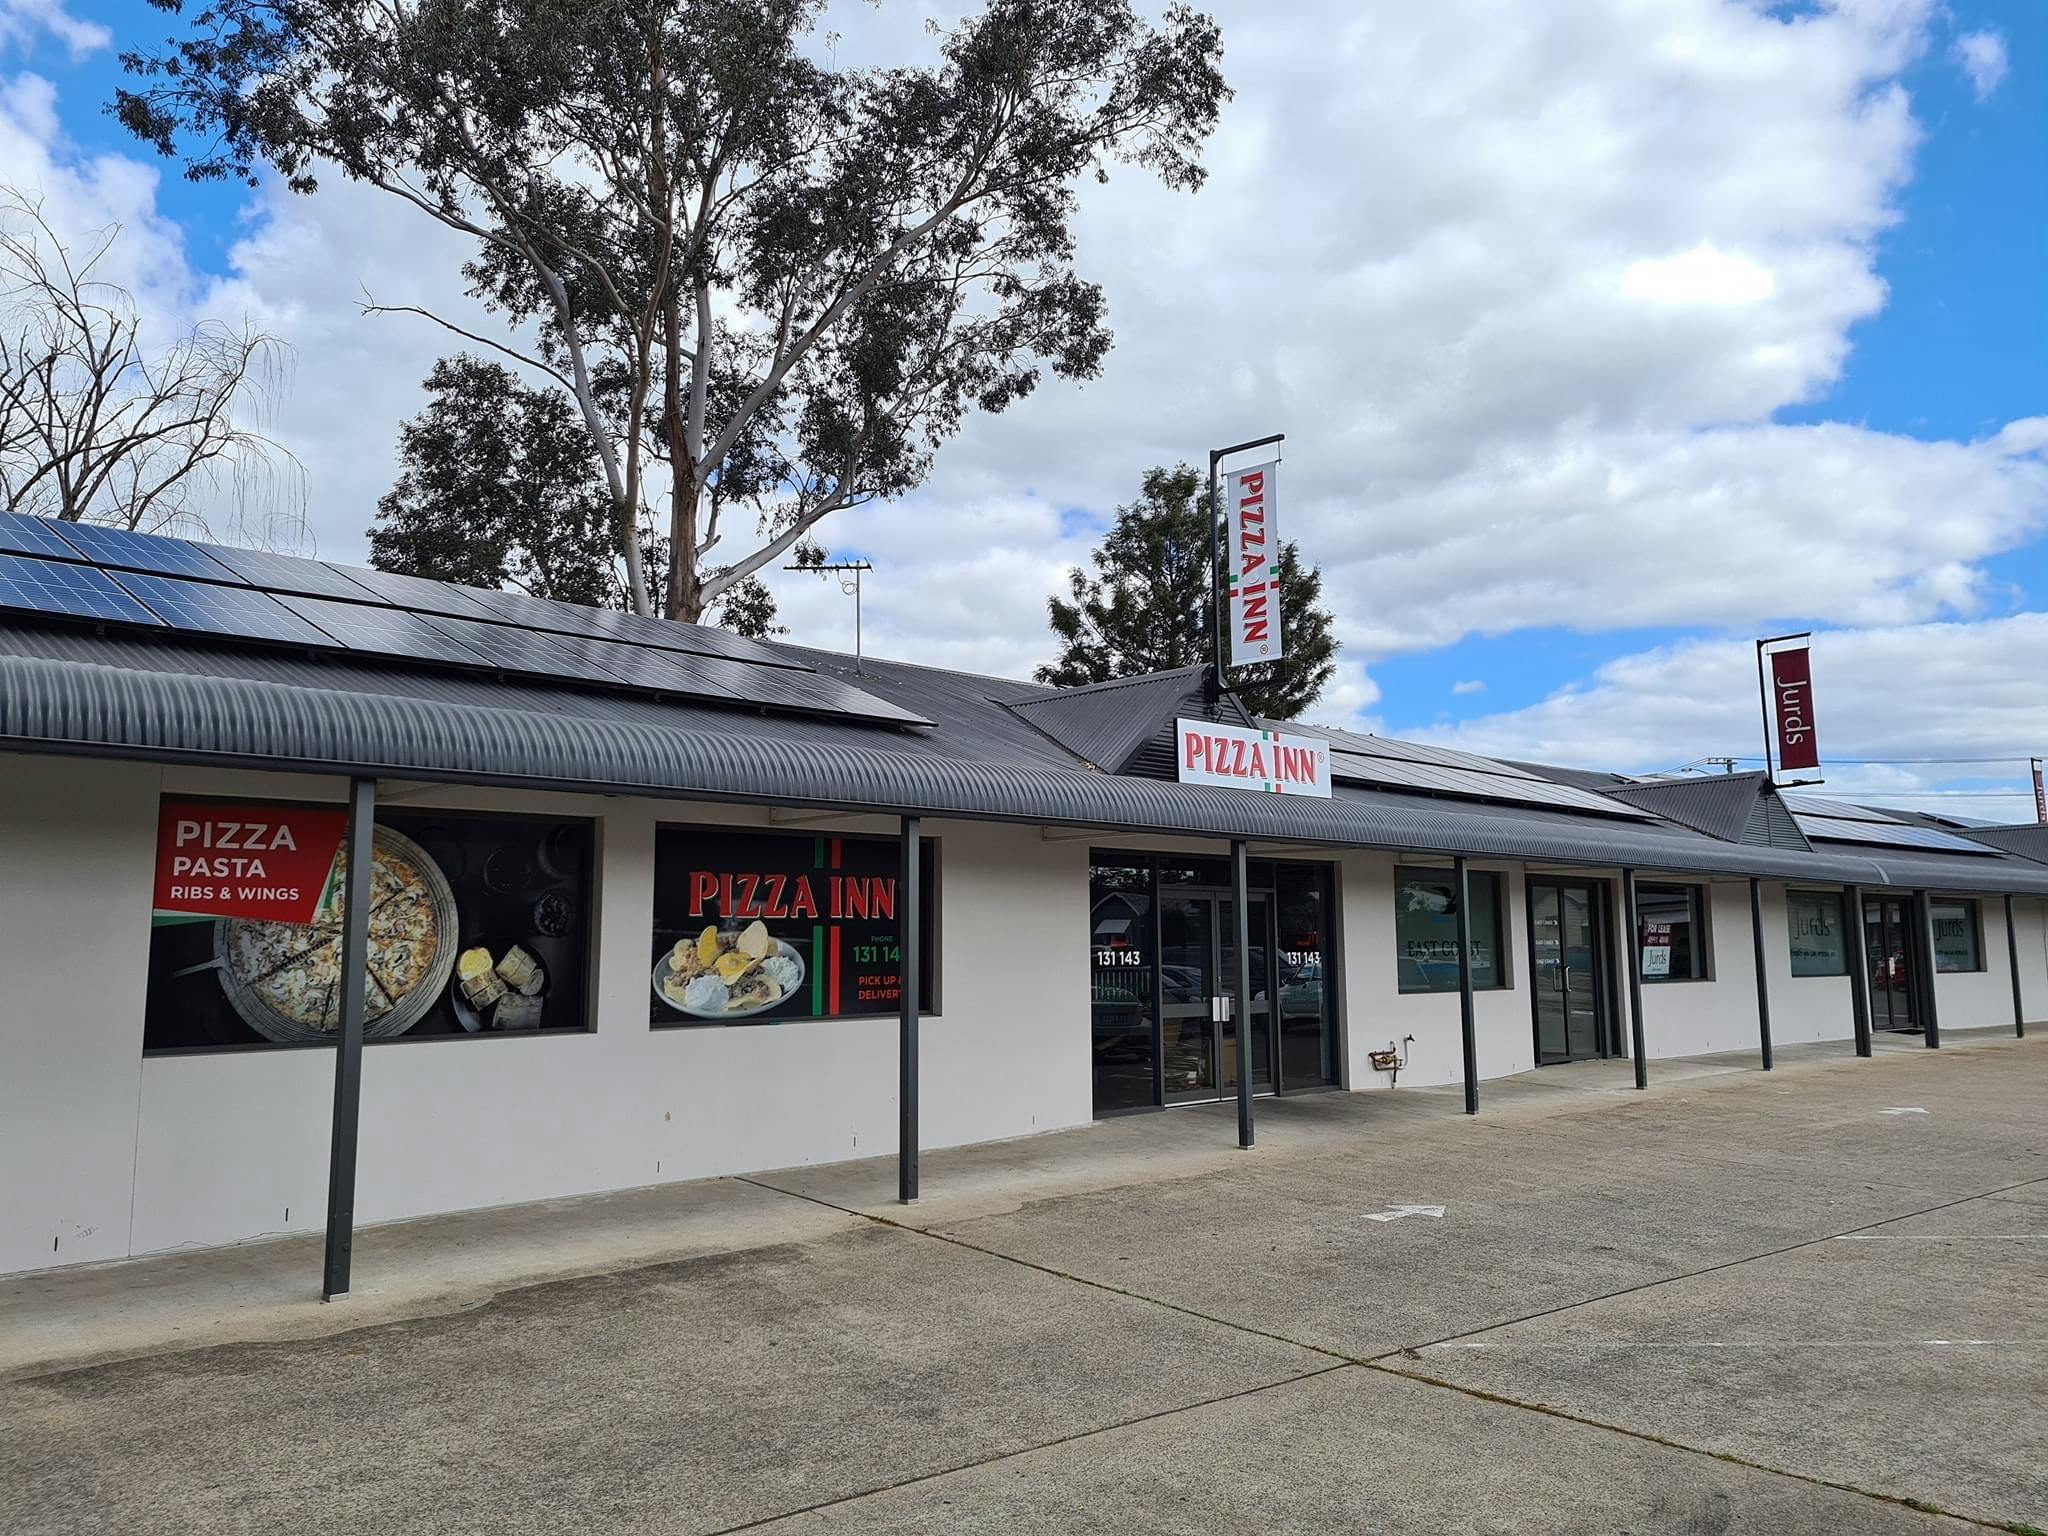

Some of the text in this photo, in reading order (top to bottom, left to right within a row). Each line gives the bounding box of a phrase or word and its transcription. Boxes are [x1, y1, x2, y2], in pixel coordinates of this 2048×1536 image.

[1240, 470, 1268, 644] PIZZA INN
[1776, 676, 1811, 745] Jurds
[1184, 731, 1316, 786] PIZZA INN
[176, 820, 297, 851] PIZZA
[173, 856, 267, 878] PASTA
[170, 886, 300, 901] RIBS & WINGS
[688, 871, 896, 920] PIZZA INN
[1647, 923, 1671, 934] FOR LEASE
[871, 935, 894, 943] PHONE
[853, 945, 901, 963] 131 14
[1287, 951, 1320, 965] 131 143
[1407, 940, 1481, 958] EAST COST
[1097, 951, 1141, 966] 131 143
[1647, 949, 1667, 968] Jurds
[858, 975, 881, 986] PICK
[883, 975, 897, 985] UP
